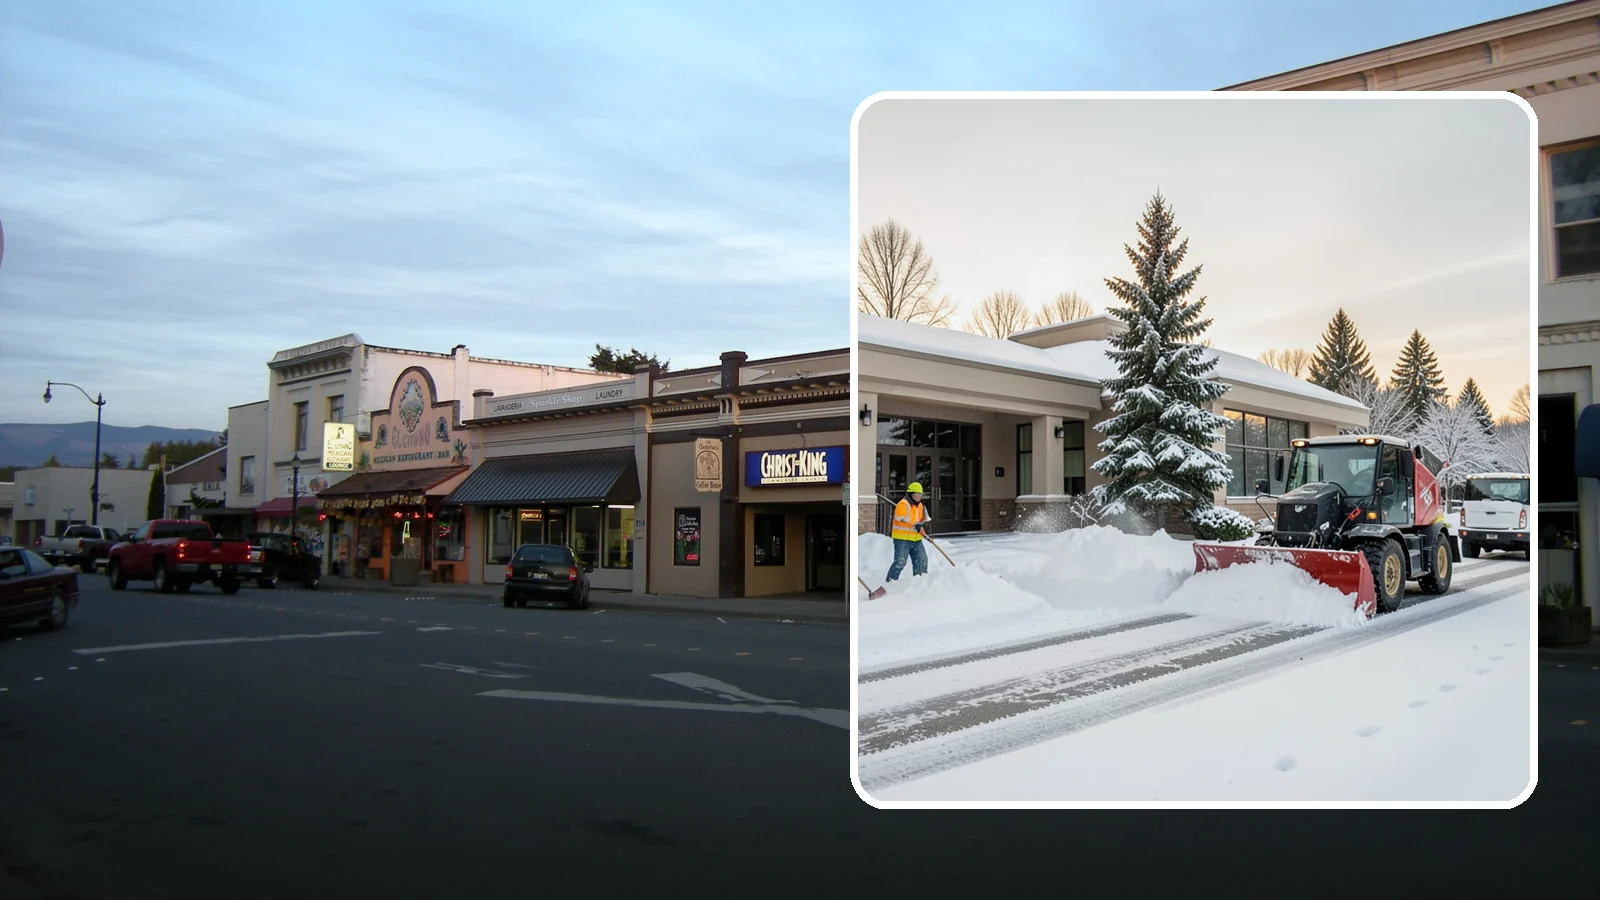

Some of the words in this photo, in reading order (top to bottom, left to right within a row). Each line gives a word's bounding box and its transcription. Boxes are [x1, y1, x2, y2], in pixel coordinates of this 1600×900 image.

[595, 388, 623, 400] LAUNDRY
[494, 402, 522, 412] LAVANDERIA
[531, 398, 561, 409] Sparkle
[562, 394, 582, 405] Shop
[373, 455, 396, 464] MEXICAN
[397, 451, 434, 462] RESTAURANT
[437, 450, 450, 459] BAR
[761, 452, 797, 478] CHRIST
[799, 450, 827, 476] KING
